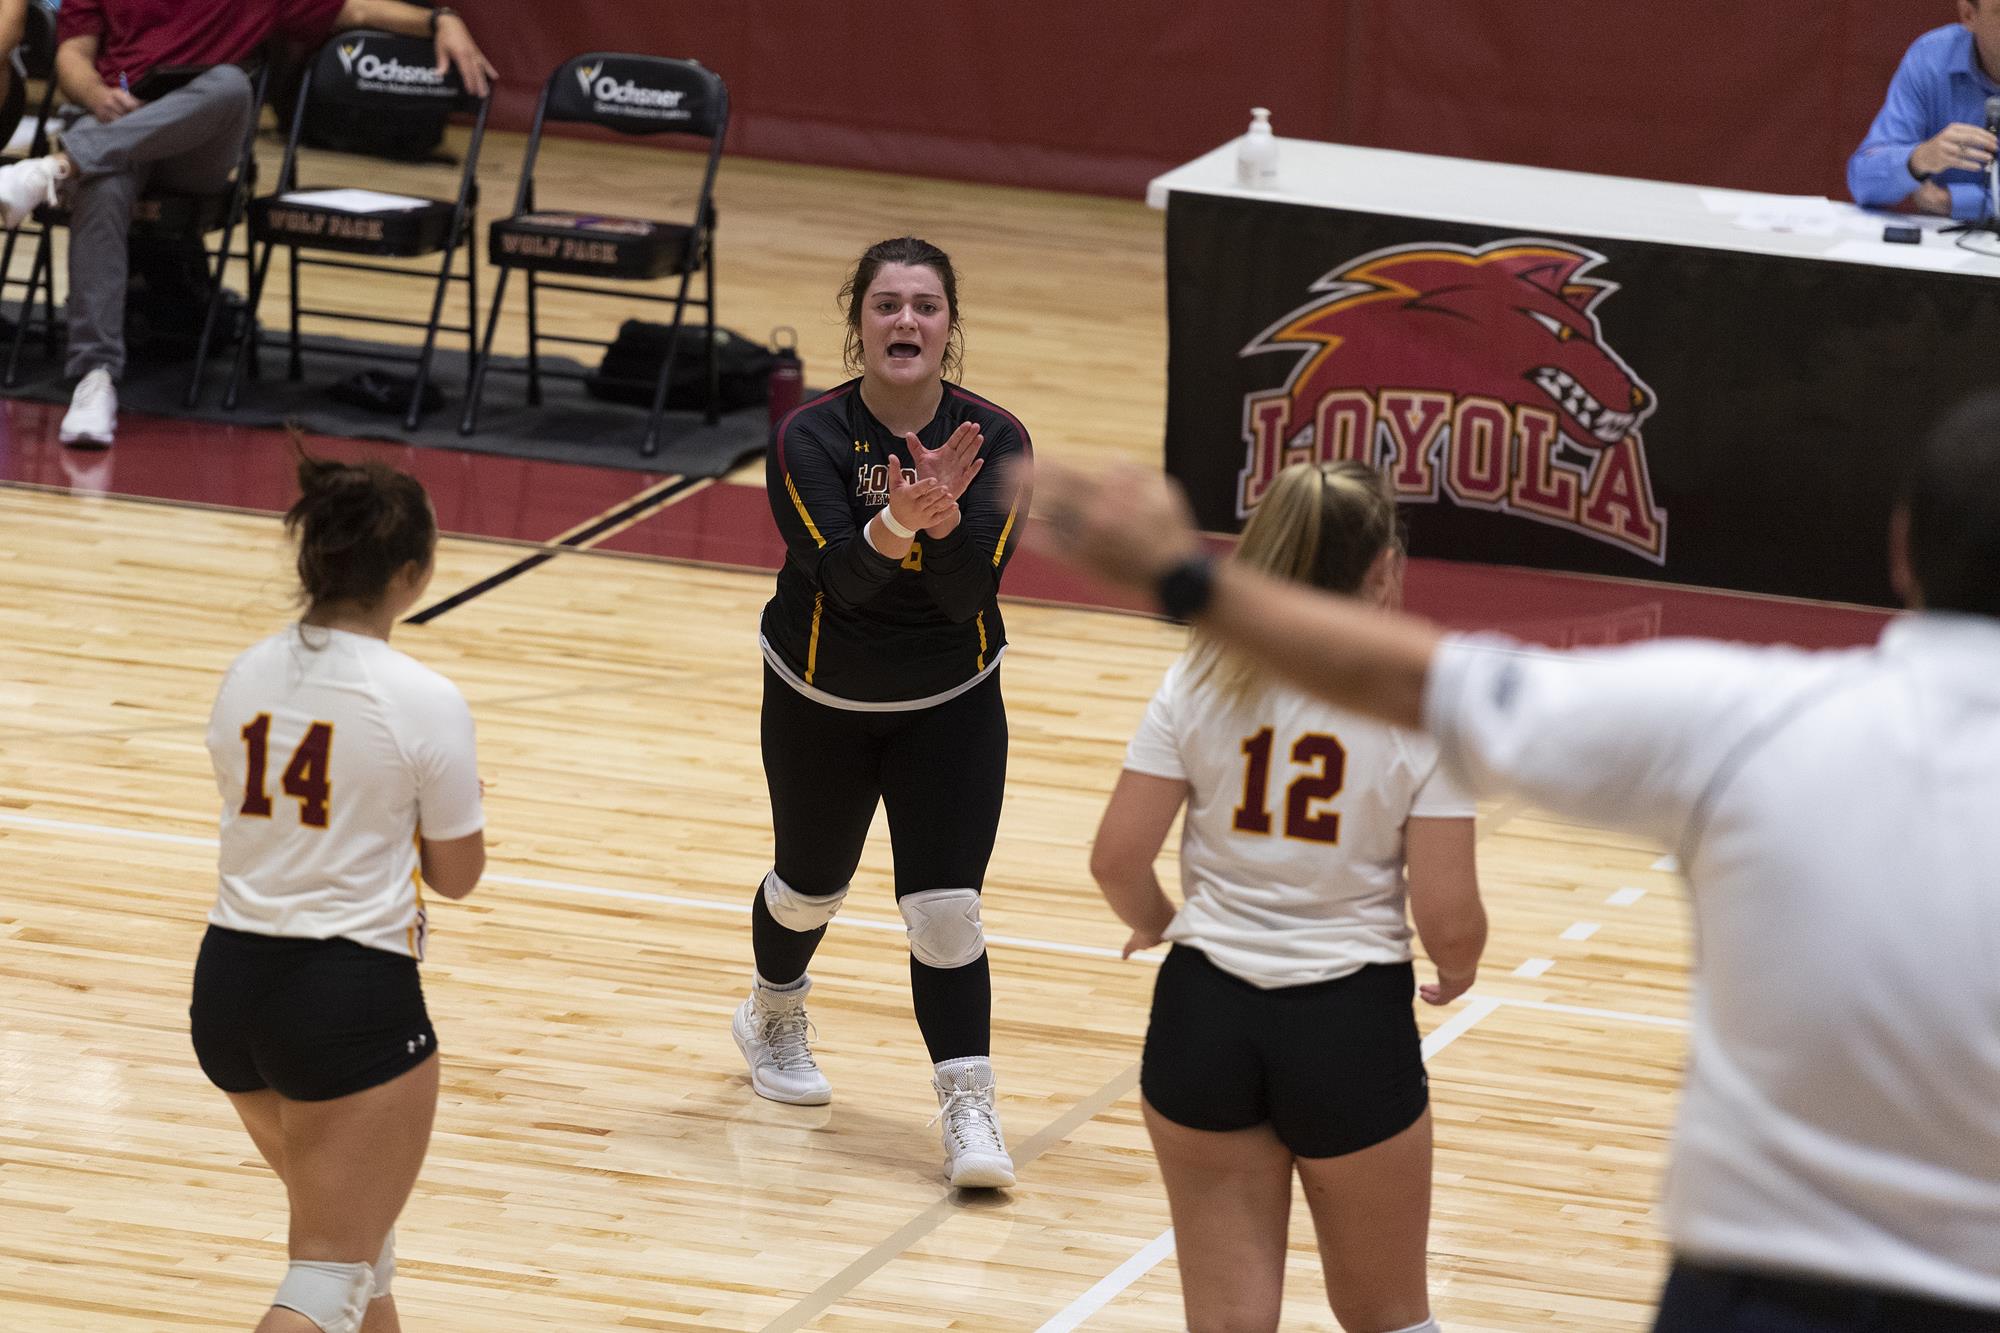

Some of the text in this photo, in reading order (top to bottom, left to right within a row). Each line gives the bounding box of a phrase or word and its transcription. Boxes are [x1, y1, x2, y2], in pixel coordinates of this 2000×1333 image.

[594, 76, 685, 108] Ochsner
[502, 233, 618, 263] WOLF PACK
[1237, 386, 1666, 564] LOYOLA
[240, 711, 334, 830] 14
[1232, 724, 1347, 847] 12
